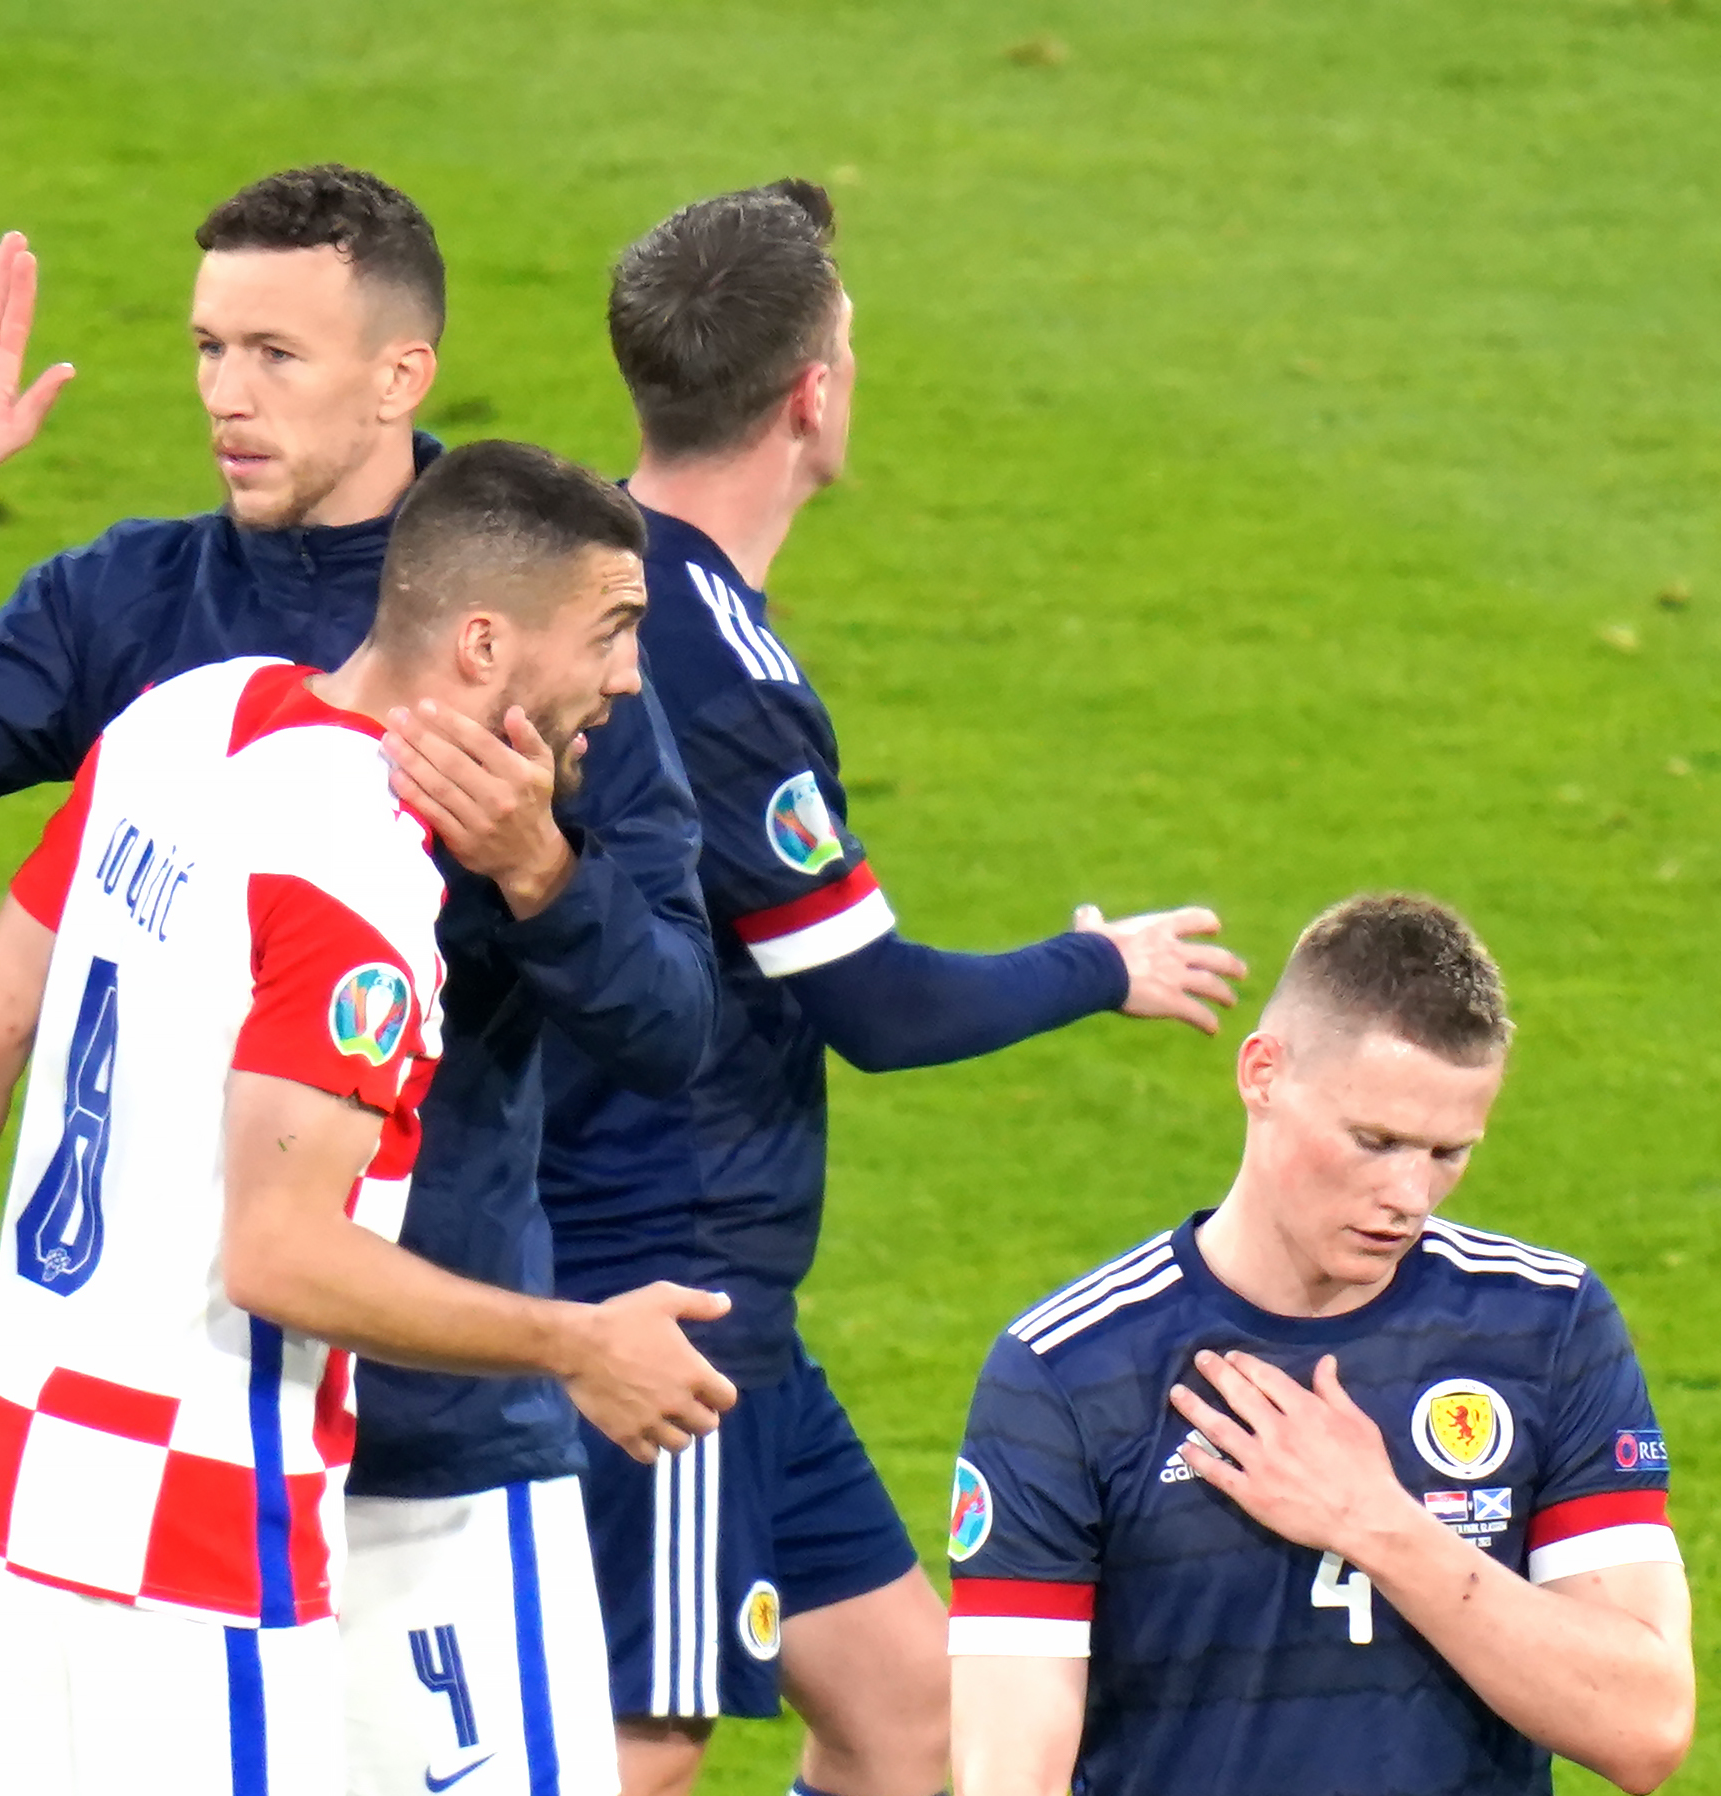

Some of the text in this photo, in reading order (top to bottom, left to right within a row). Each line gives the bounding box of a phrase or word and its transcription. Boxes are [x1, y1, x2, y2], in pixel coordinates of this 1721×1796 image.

[17, 956, 118, 1297] 8
[1311, 1550, 1373, 1644] 4
[408, 1624, 478, 1748] 4
